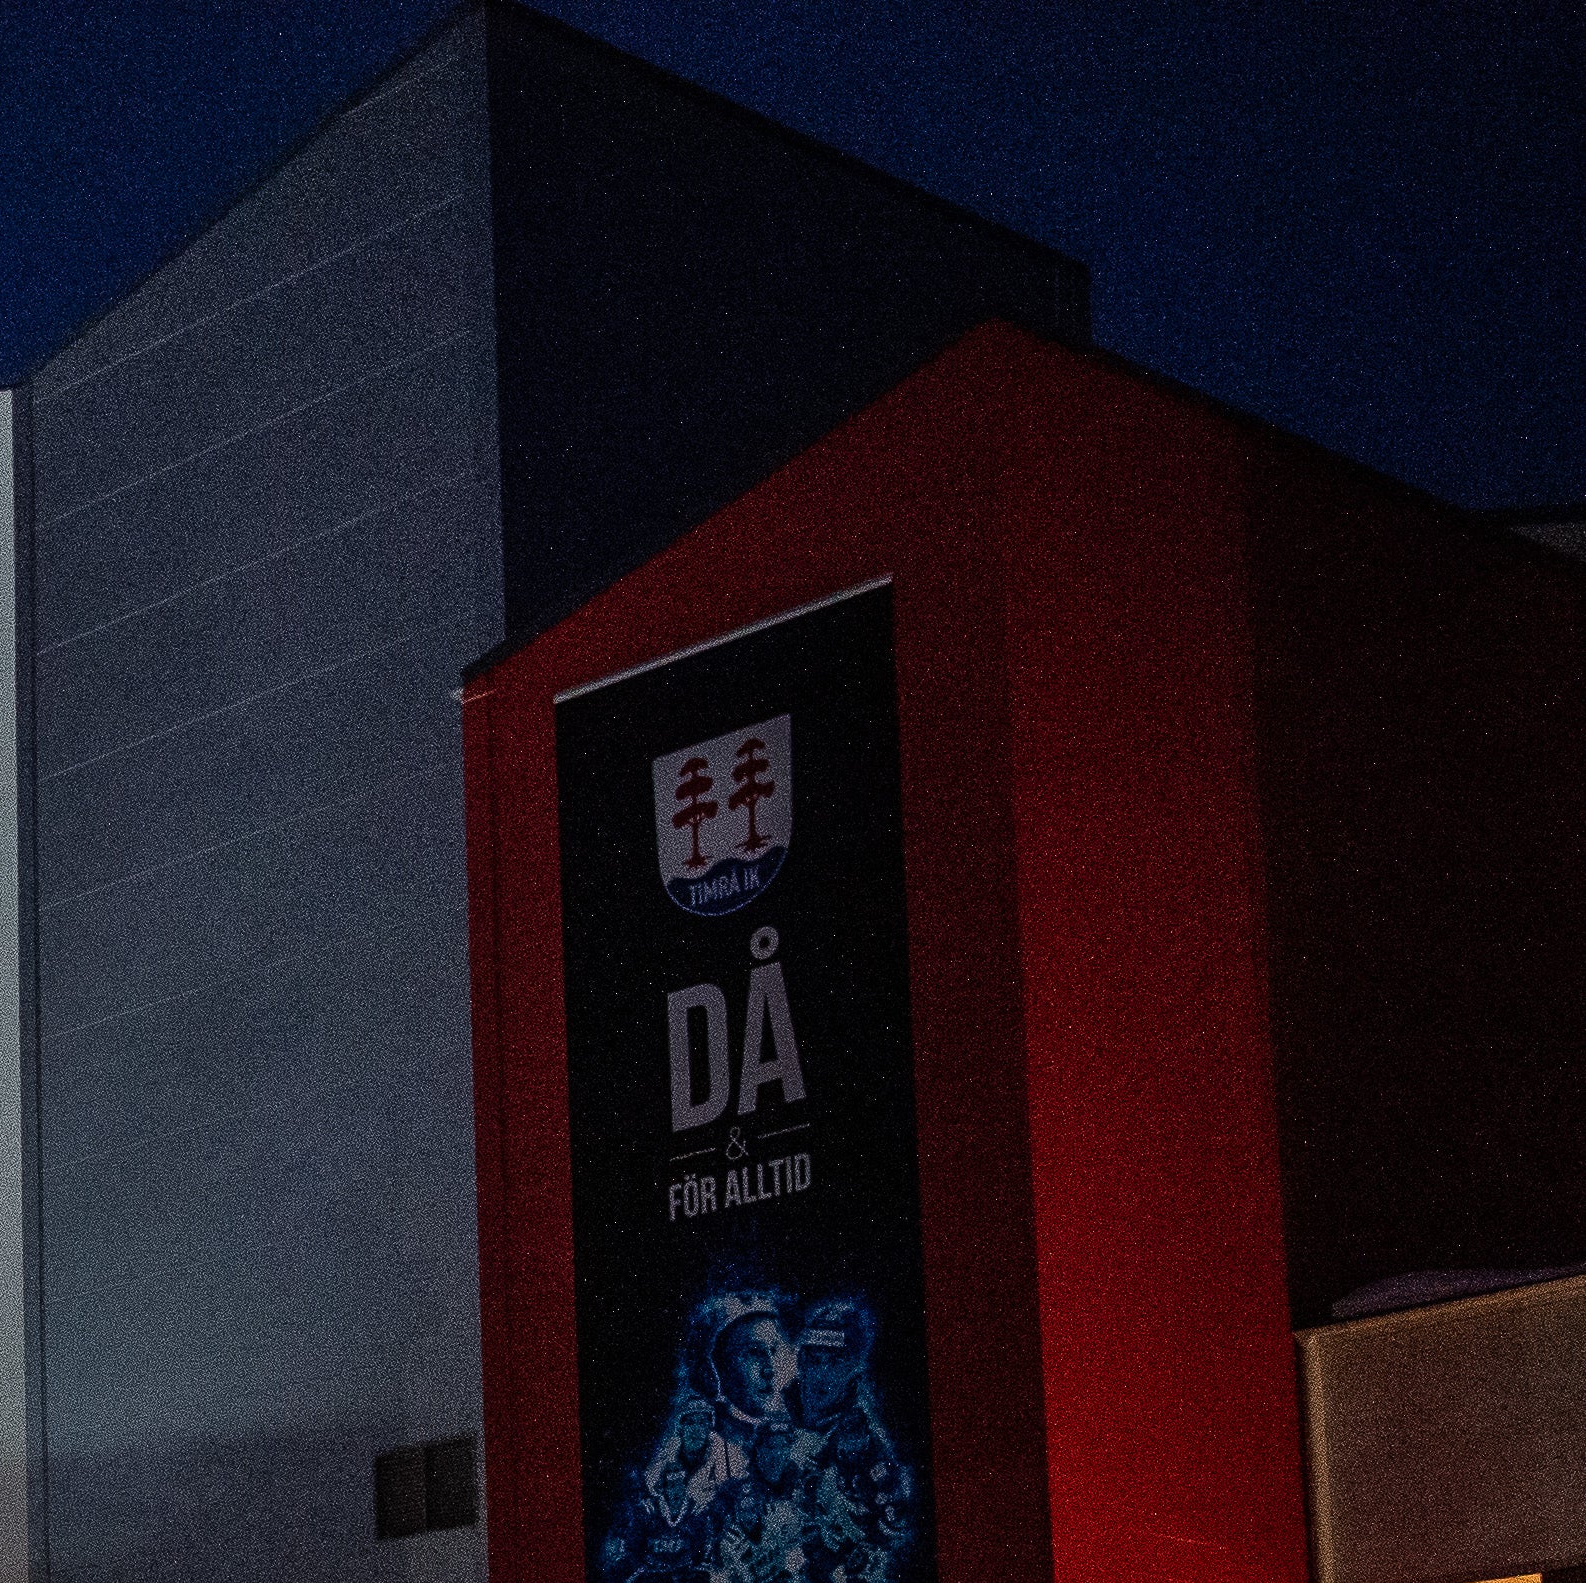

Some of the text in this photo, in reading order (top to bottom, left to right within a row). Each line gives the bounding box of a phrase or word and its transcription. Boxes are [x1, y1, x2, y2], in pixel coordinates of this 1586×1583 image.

[667, 926, 806, 1132] DÅ
[669, 1152, 811, 1222] FÖR ALLTID
